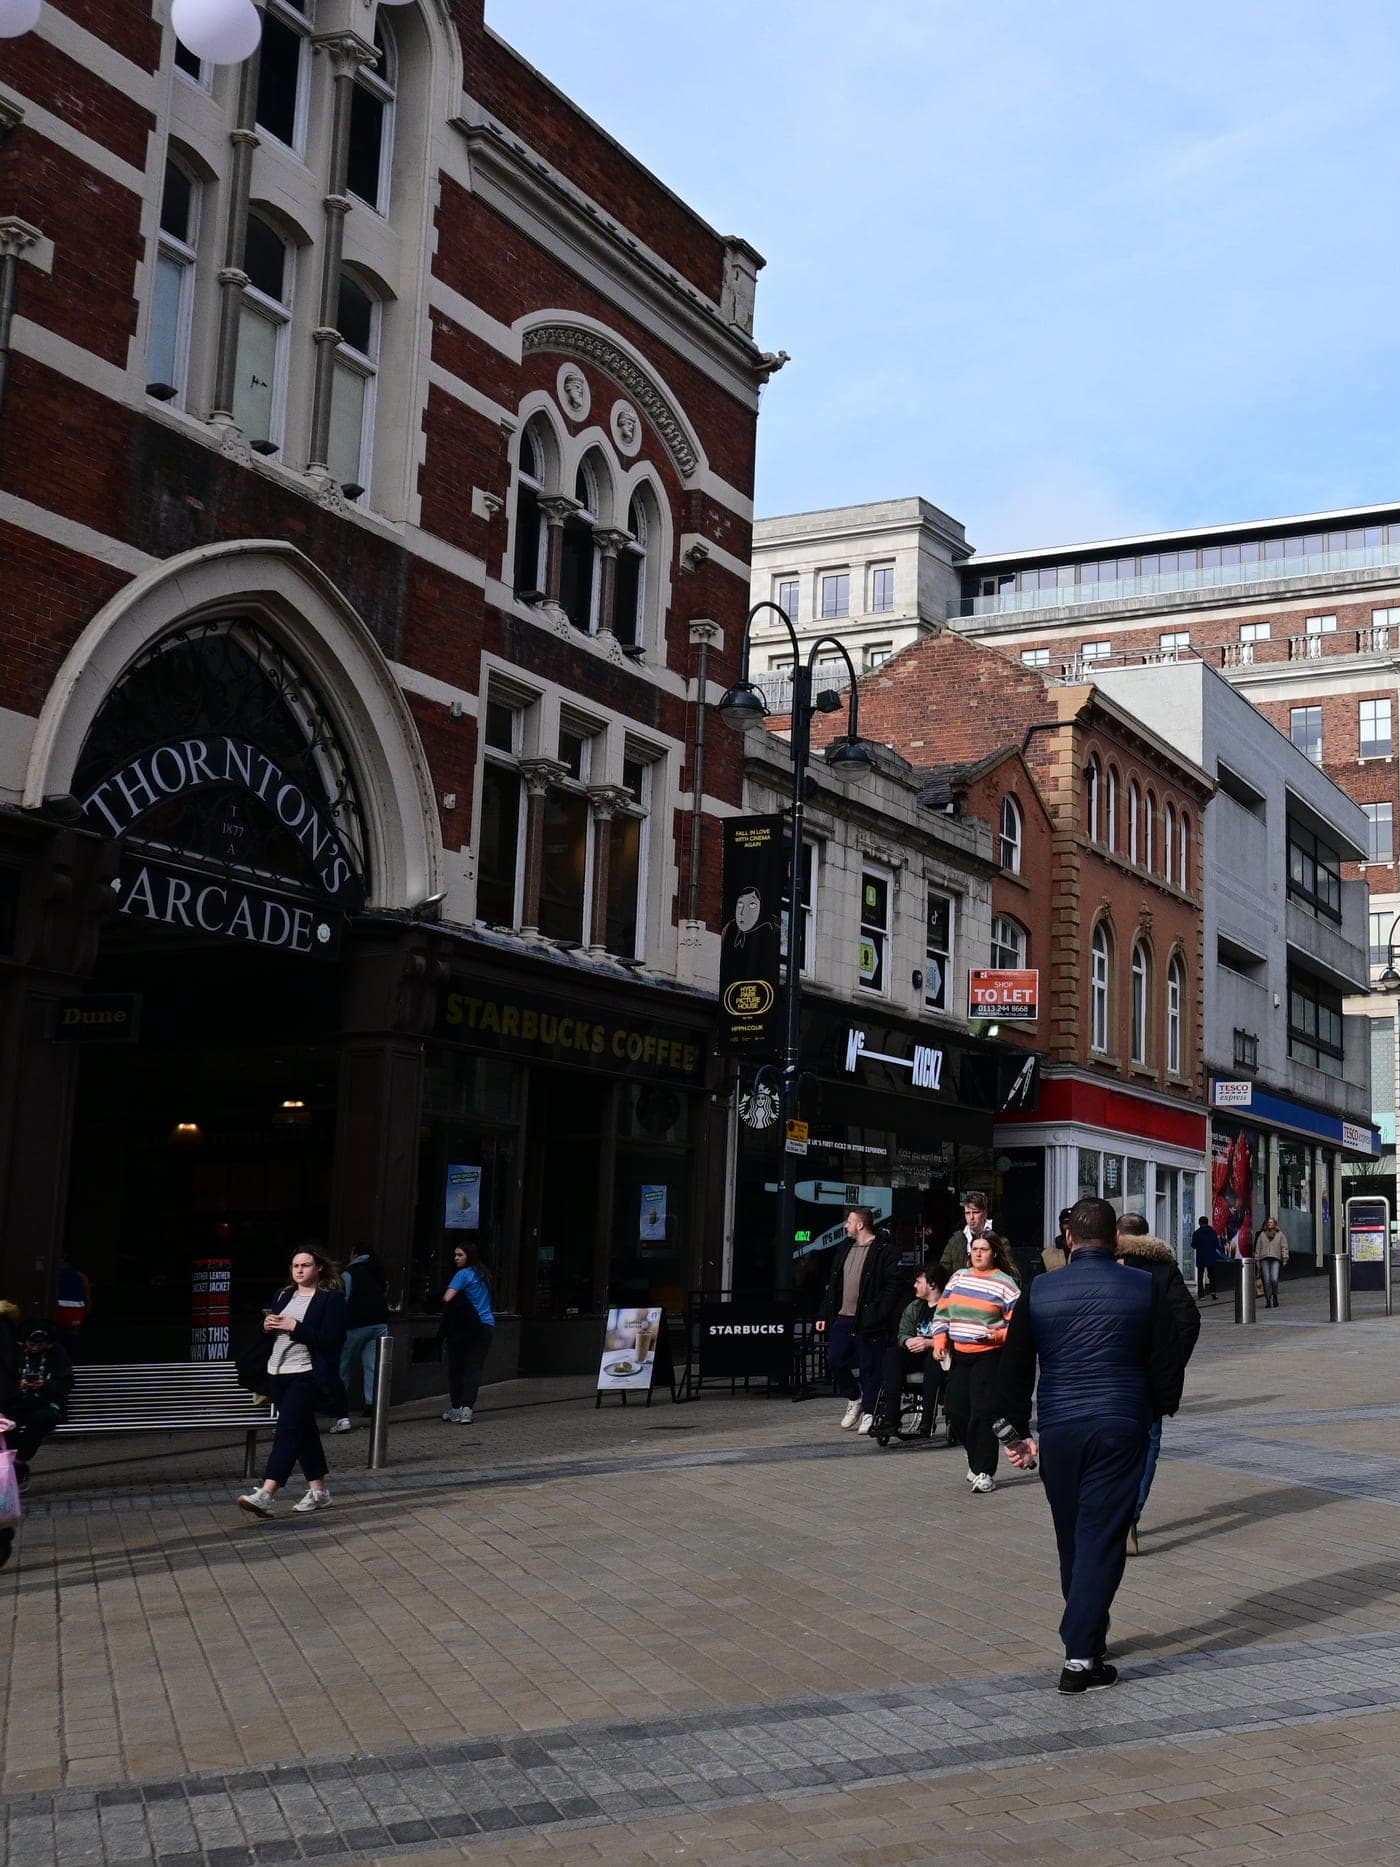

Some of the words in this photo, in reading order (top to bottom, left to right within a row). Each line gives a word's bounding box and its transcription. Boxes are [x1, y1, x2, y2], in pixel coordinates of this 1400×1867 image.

[81, 736, 352, 893] THORNTON'S
[222, 821, 244, 838] 1877
[119, 866, 314, 952] ARCADE
[974, 989, 997, 1002] TO
[1003, 989, 1033, 1003] LET
[996, 1005, 1010, 1013] 244
[1011, 1005, 1029, 1013] 8668
[63, 1008, 128, 1025] Dune
[446, 992, 607, 1055] STARBUCKS
[611, 1029, 698, 1073] COFFEE
[1219, 1095, 1247, 1103] express
[1344, 1126, 1359, 1140] TESCO
[209, 1271, 230, 1280] LEATHER
[209, 1281, 230, 1292] JACKET
[208, 1327, 230, 1342] THIS
[709, 1324, 785, 1335] STARBUCKS
[208, 1343, 230, 1360] WAY
